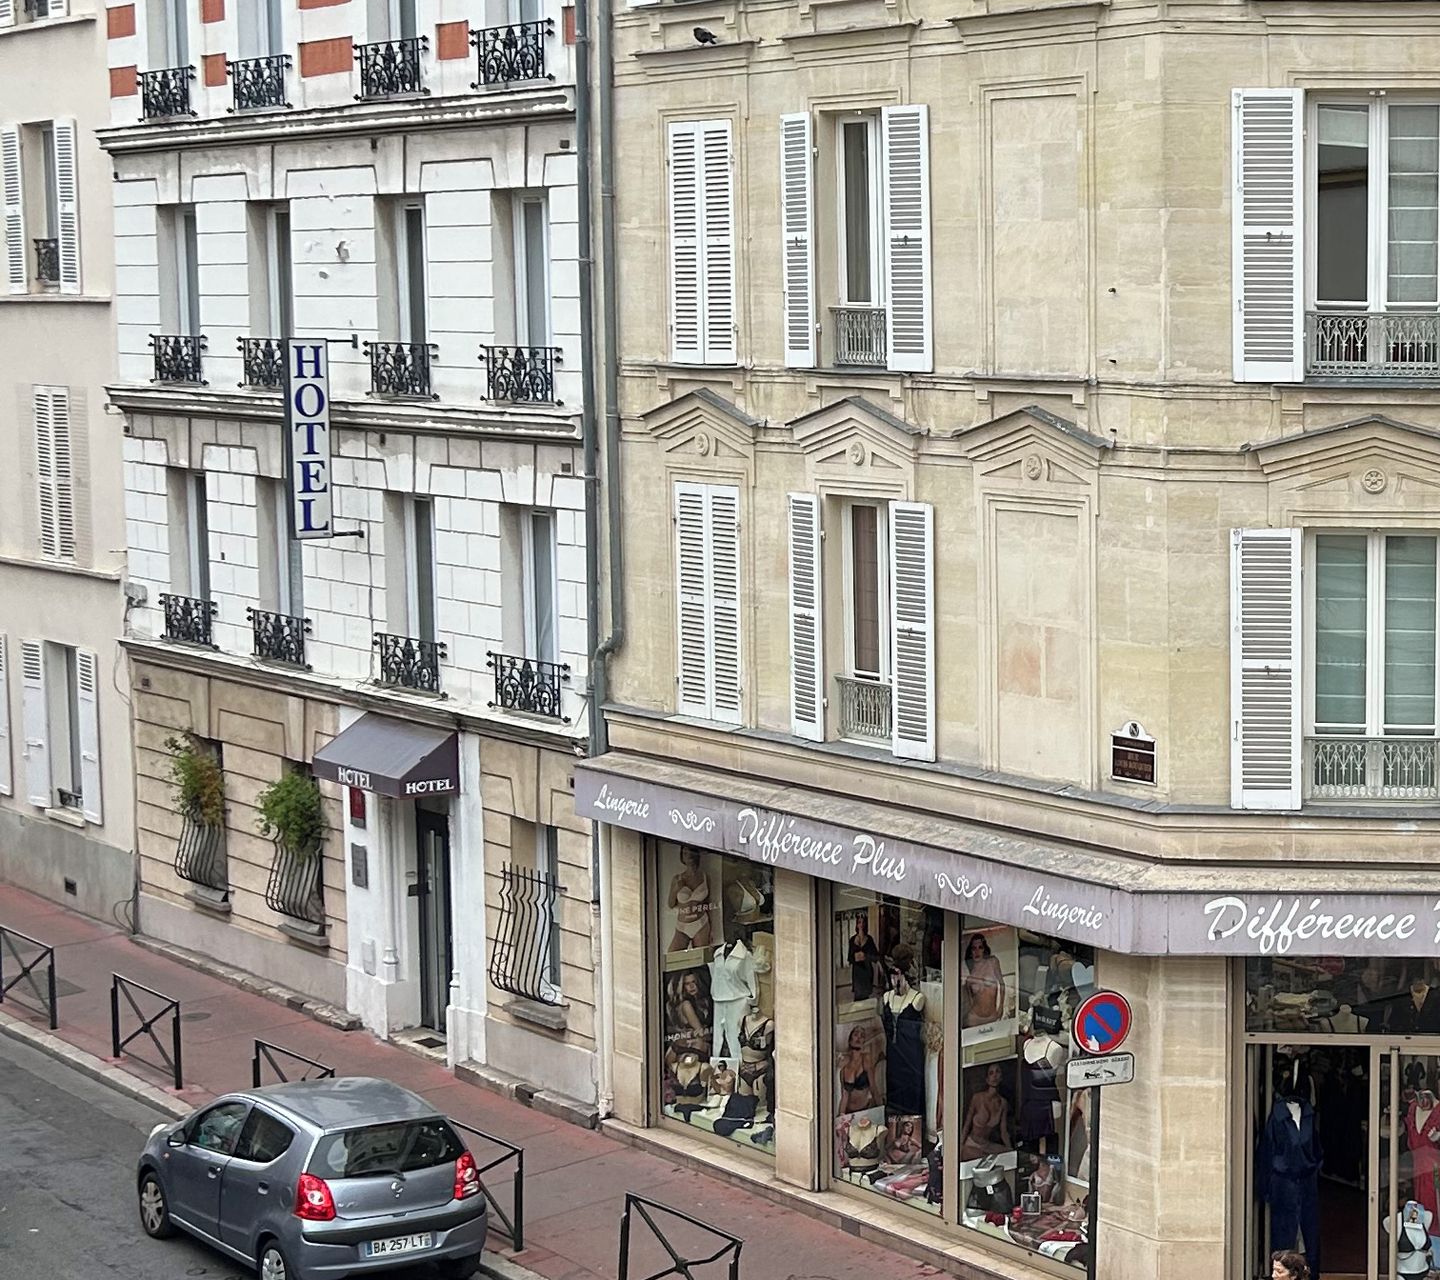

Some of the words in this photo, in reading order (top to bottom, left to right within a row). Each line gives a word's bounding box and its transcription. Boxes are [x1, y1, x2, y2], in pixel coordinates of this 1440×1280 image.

[292, 345, 328, 532] HOTEL
[338, 766, 373, 790] HOTEL
[405, 778, 455, 794] HOTEL
[593, 783, 650, 820] Lingerie
[737, 807, 843, 864] Différence
[851, 833, 907, 881] Plus
[1022, 884, 1103, 931] Lingerie
[1203, 896, 1417, 955] Différence
